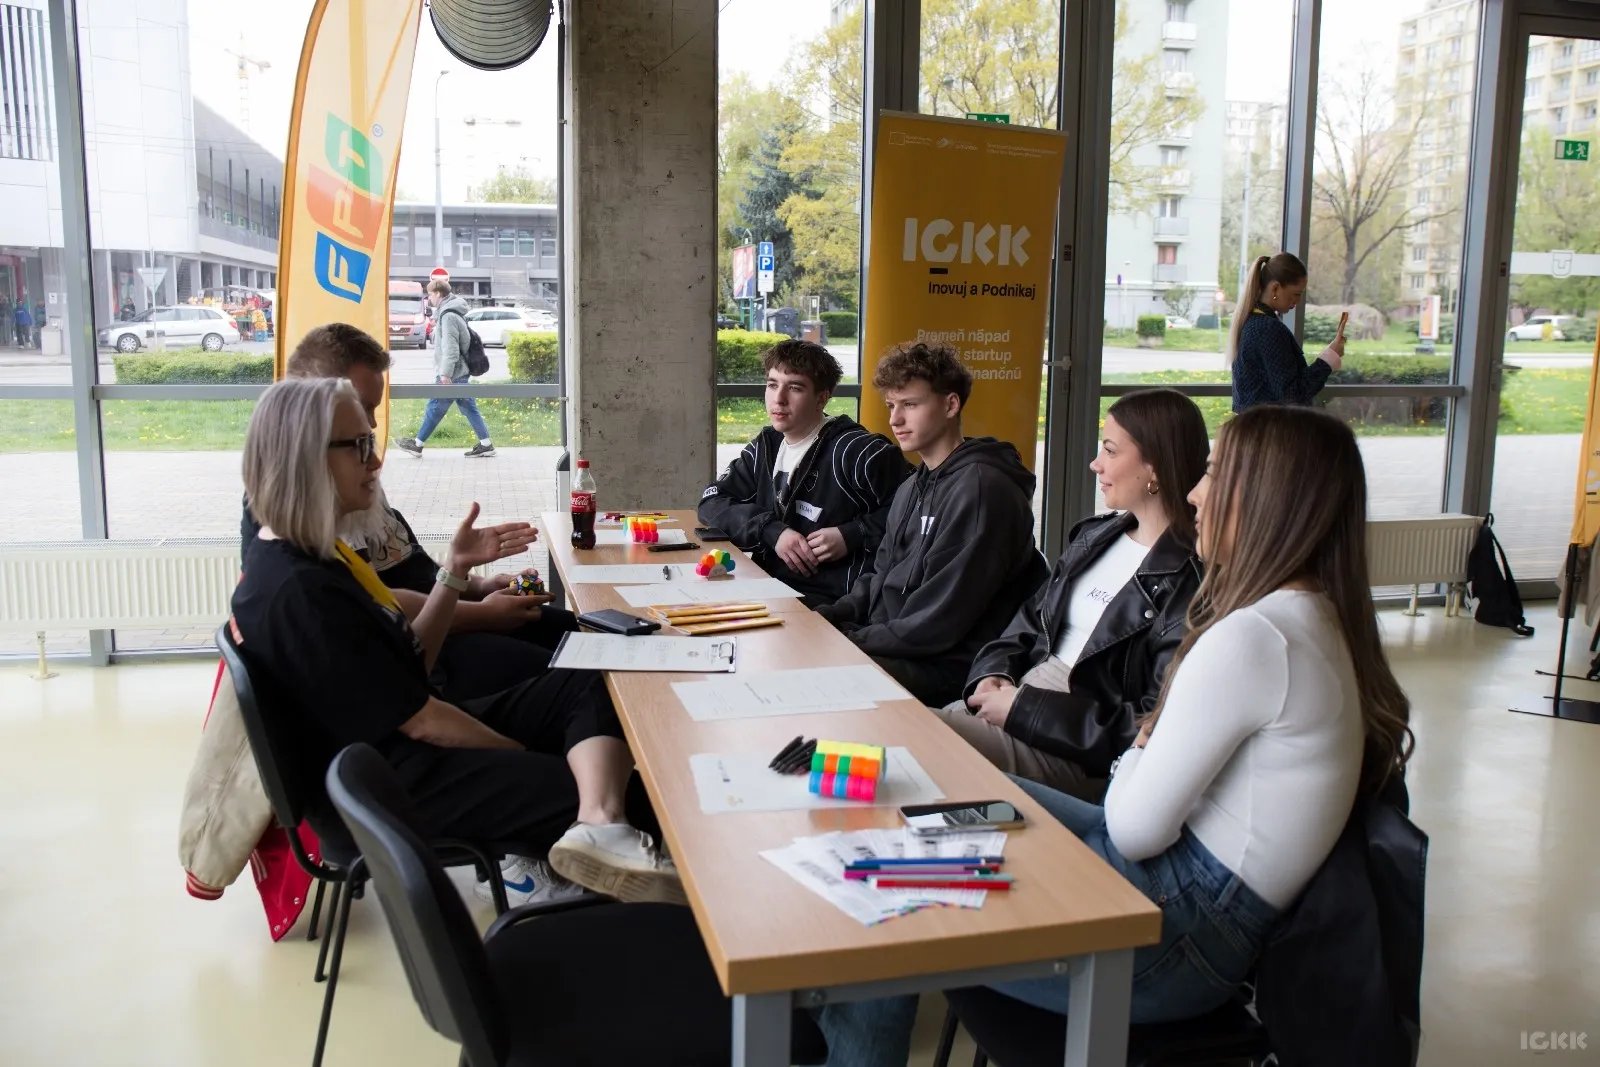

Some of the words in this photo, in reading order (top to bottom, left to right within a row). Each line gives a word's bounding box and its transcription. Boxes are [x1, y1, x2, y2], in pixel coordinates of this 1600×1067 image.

[928, 281, 967, 298] Inovuj
[970, 284, 978, 296] a
[981, 283, 1037, 300] Podnikaj
[968, 328, 1011, 345] nápad
[963, 348, 1012, 364] startup
